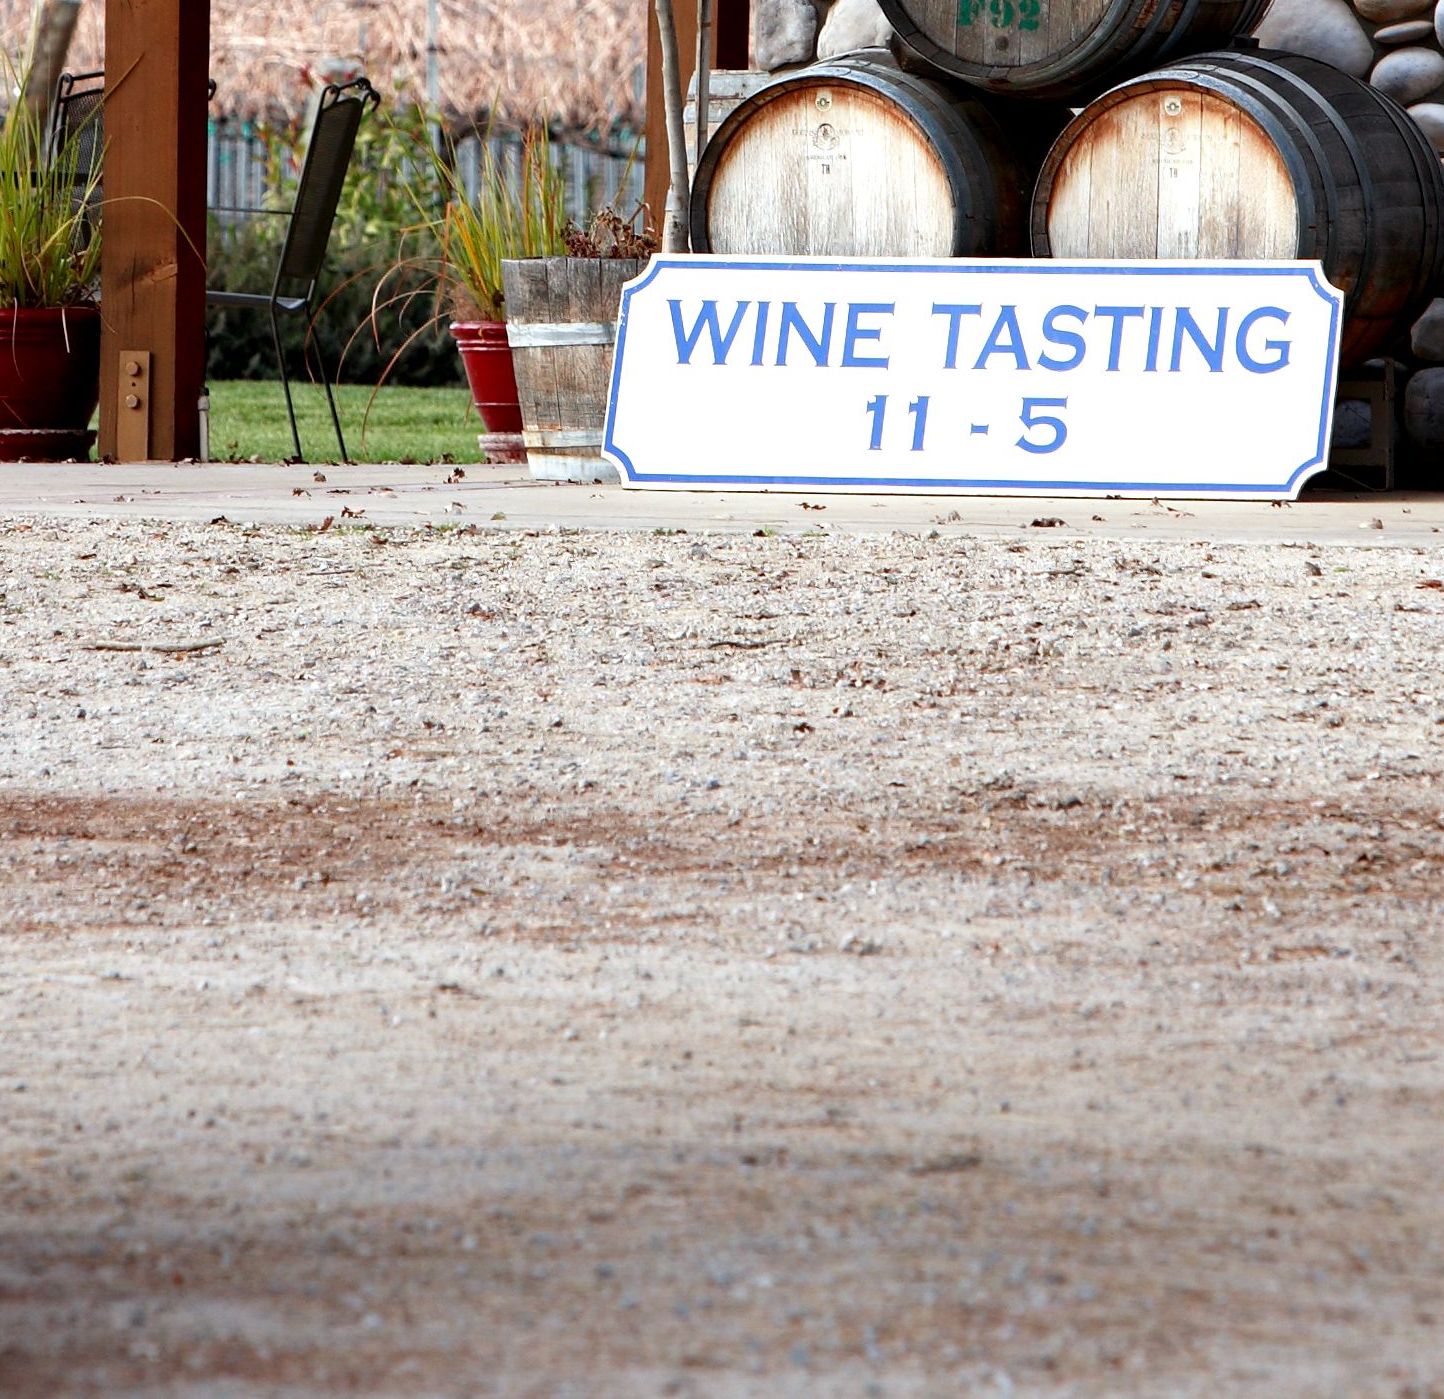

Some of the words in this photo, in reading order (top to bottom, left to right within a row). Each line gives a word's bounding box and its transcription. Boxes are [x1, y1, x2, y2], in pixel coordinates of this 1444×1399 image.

[667, 298, 896, 369] WINE
[931, 302, 1292, 374] TASTING
[866, 394, 930, 452] 11
[970, 423, 989, 435] -
[1015, 396, 1068, 455] 5
